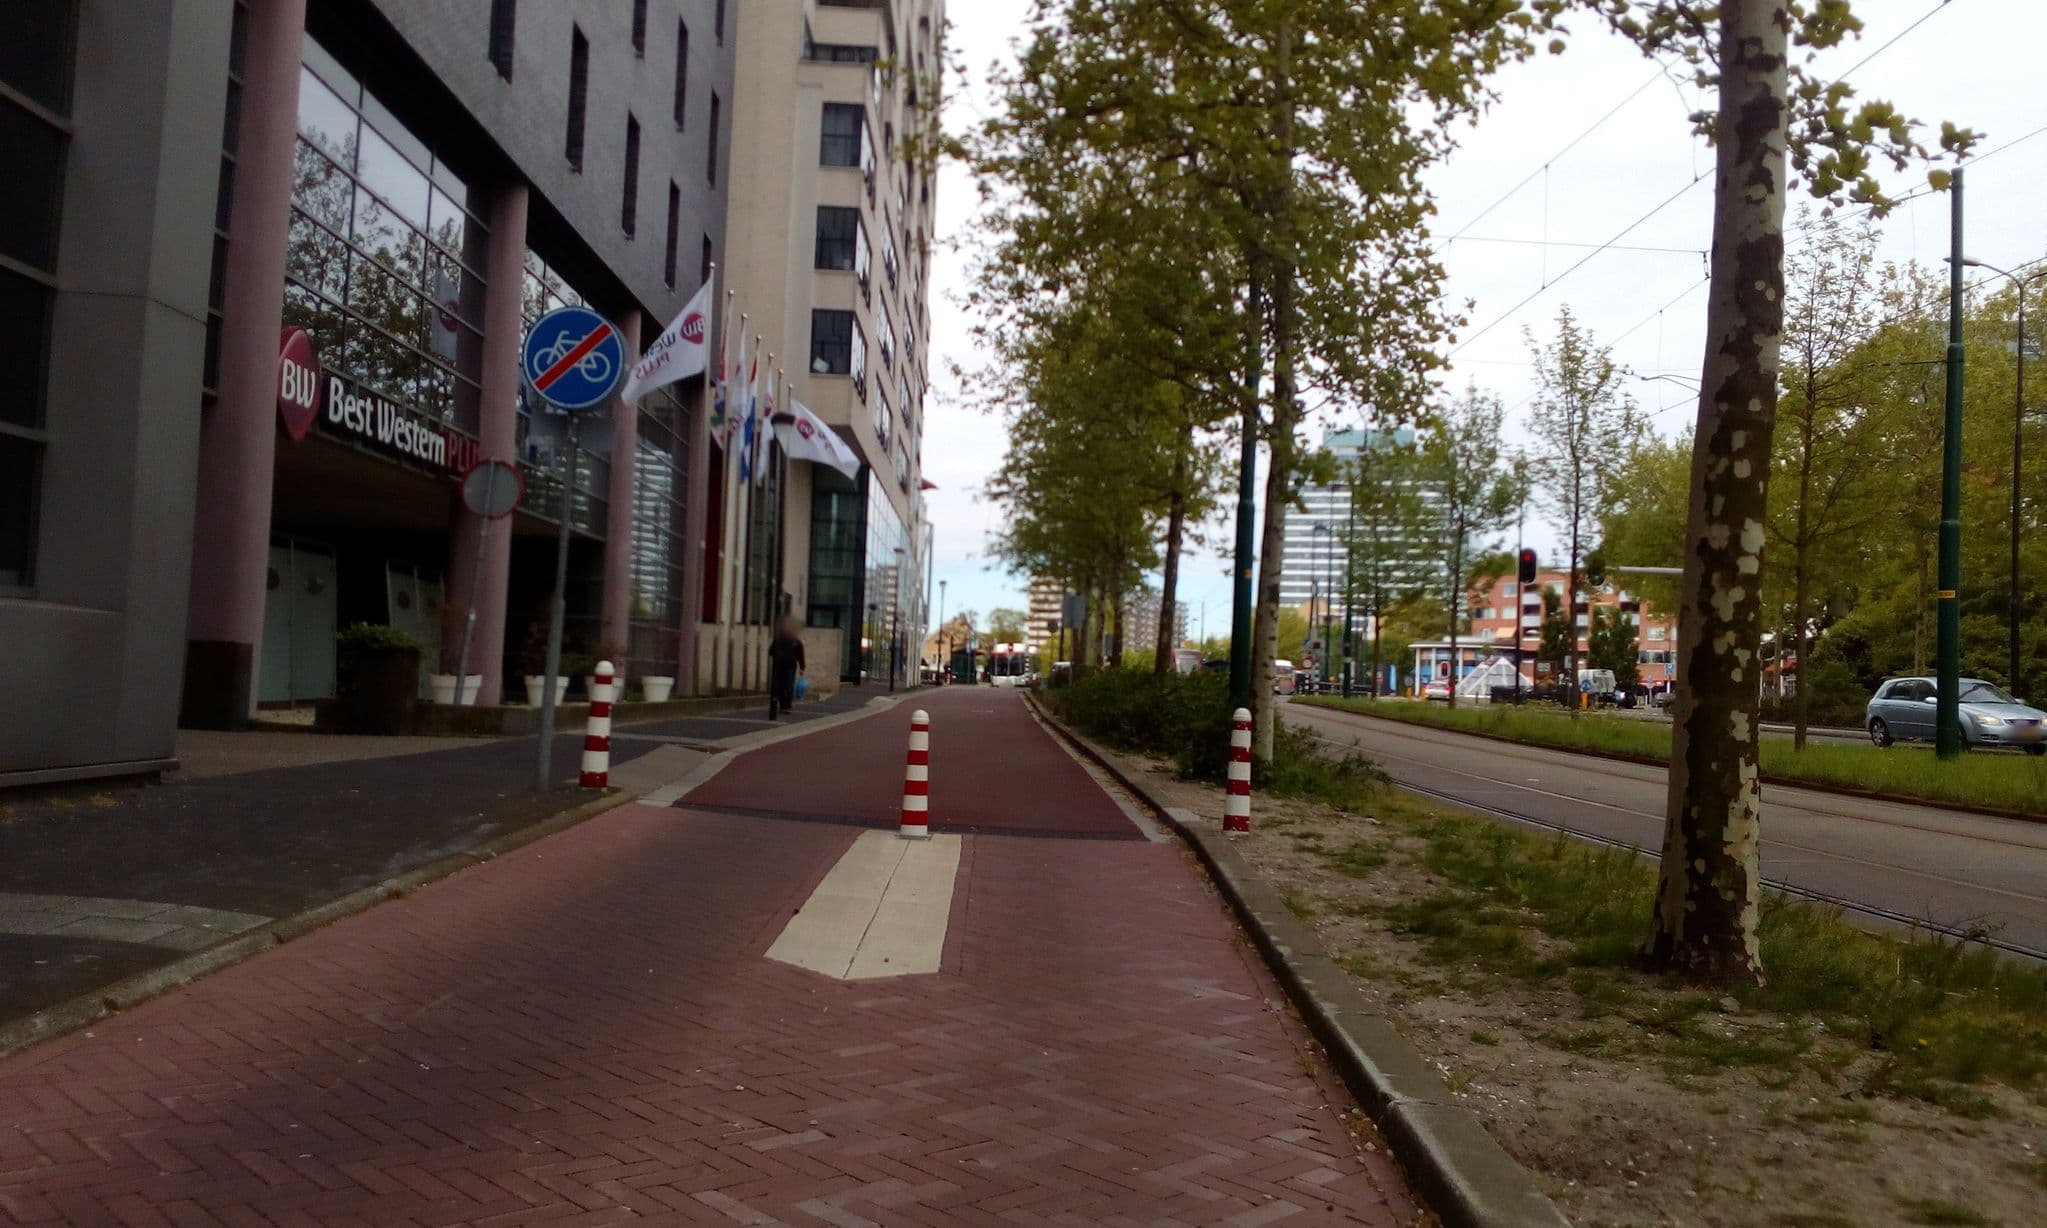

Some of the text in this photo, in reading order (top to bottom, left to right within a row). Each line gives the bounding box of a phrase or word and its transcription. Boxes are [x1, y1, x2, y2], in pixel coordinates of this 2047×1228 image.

[281, 358, 315, 408] BW
[329, 376, 480, 472] Best Western PLU
